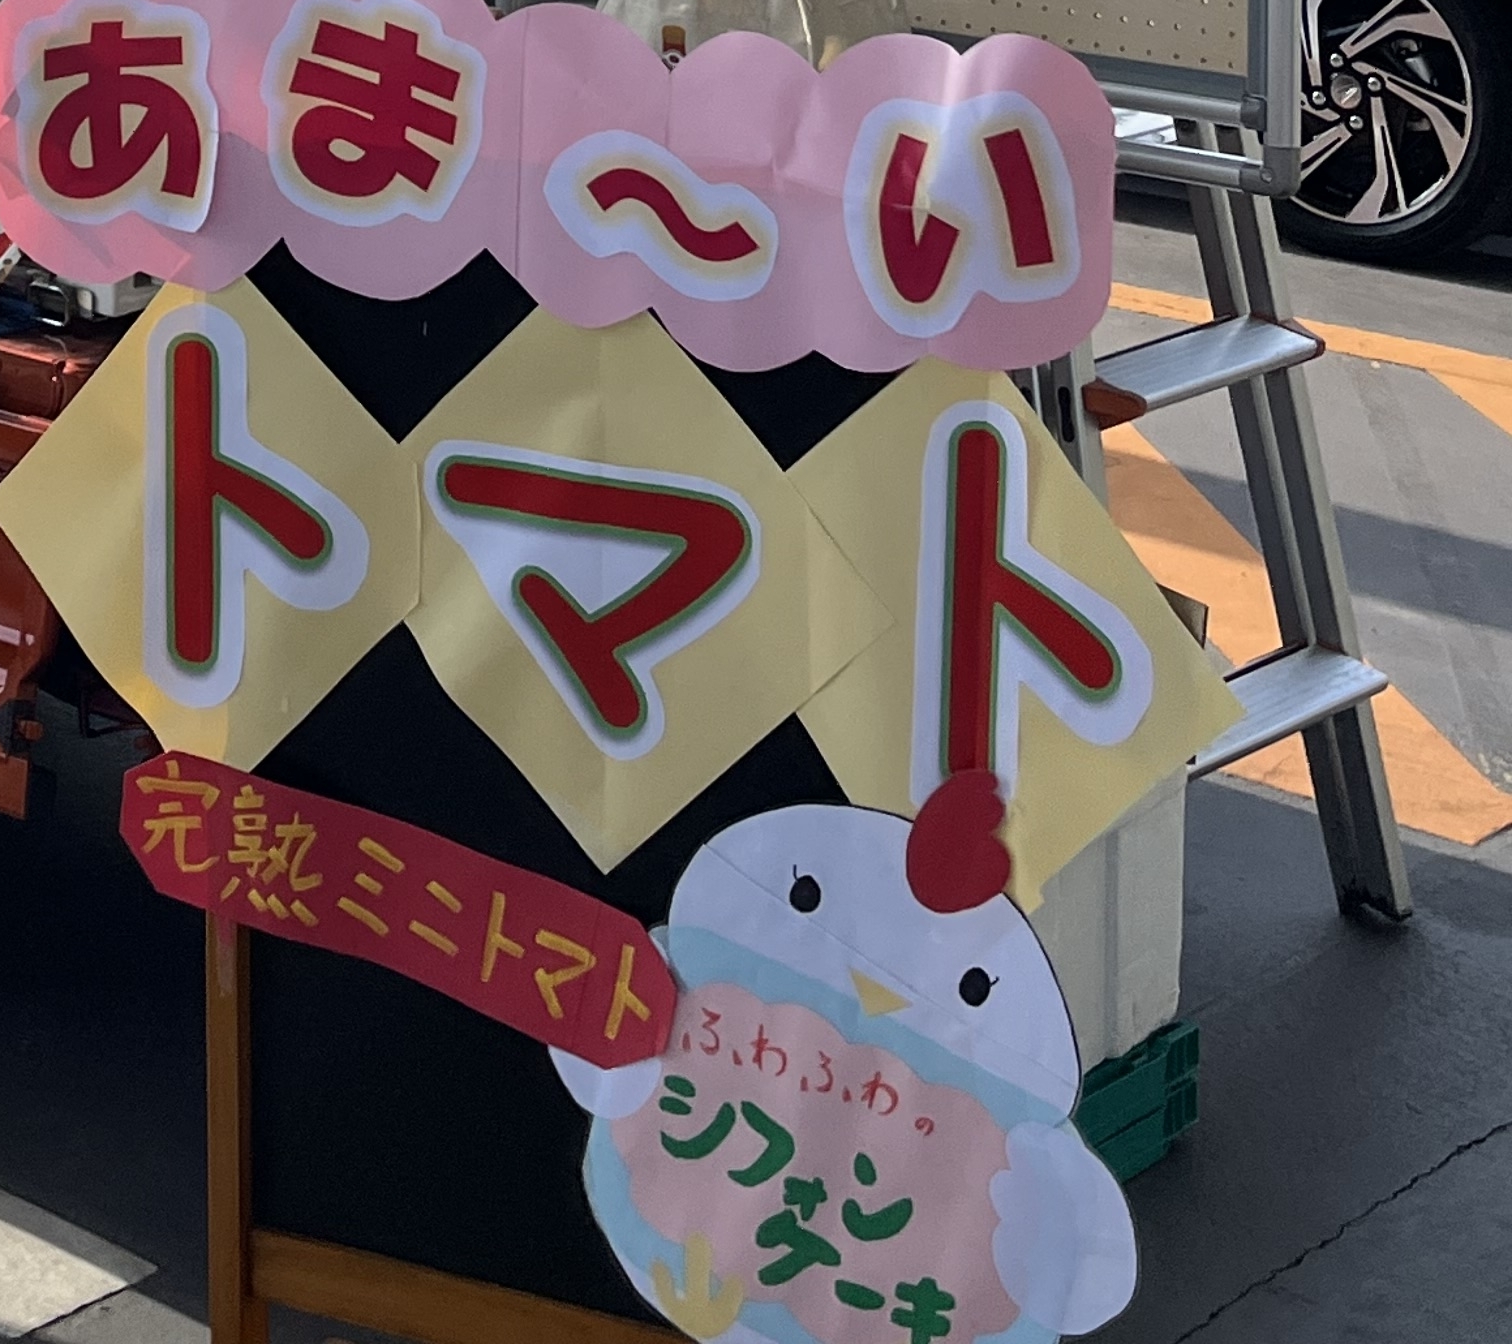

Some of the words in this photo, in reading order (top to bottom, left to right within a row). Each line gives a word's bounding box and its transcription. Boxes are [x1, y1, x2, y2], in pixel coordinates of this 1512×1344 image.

[164, 331, 1123, 778] トマト
[136, 760, 652, 1041] 完熟ミニトマト
[682, 1007, 935, 1137] ふわふわの
